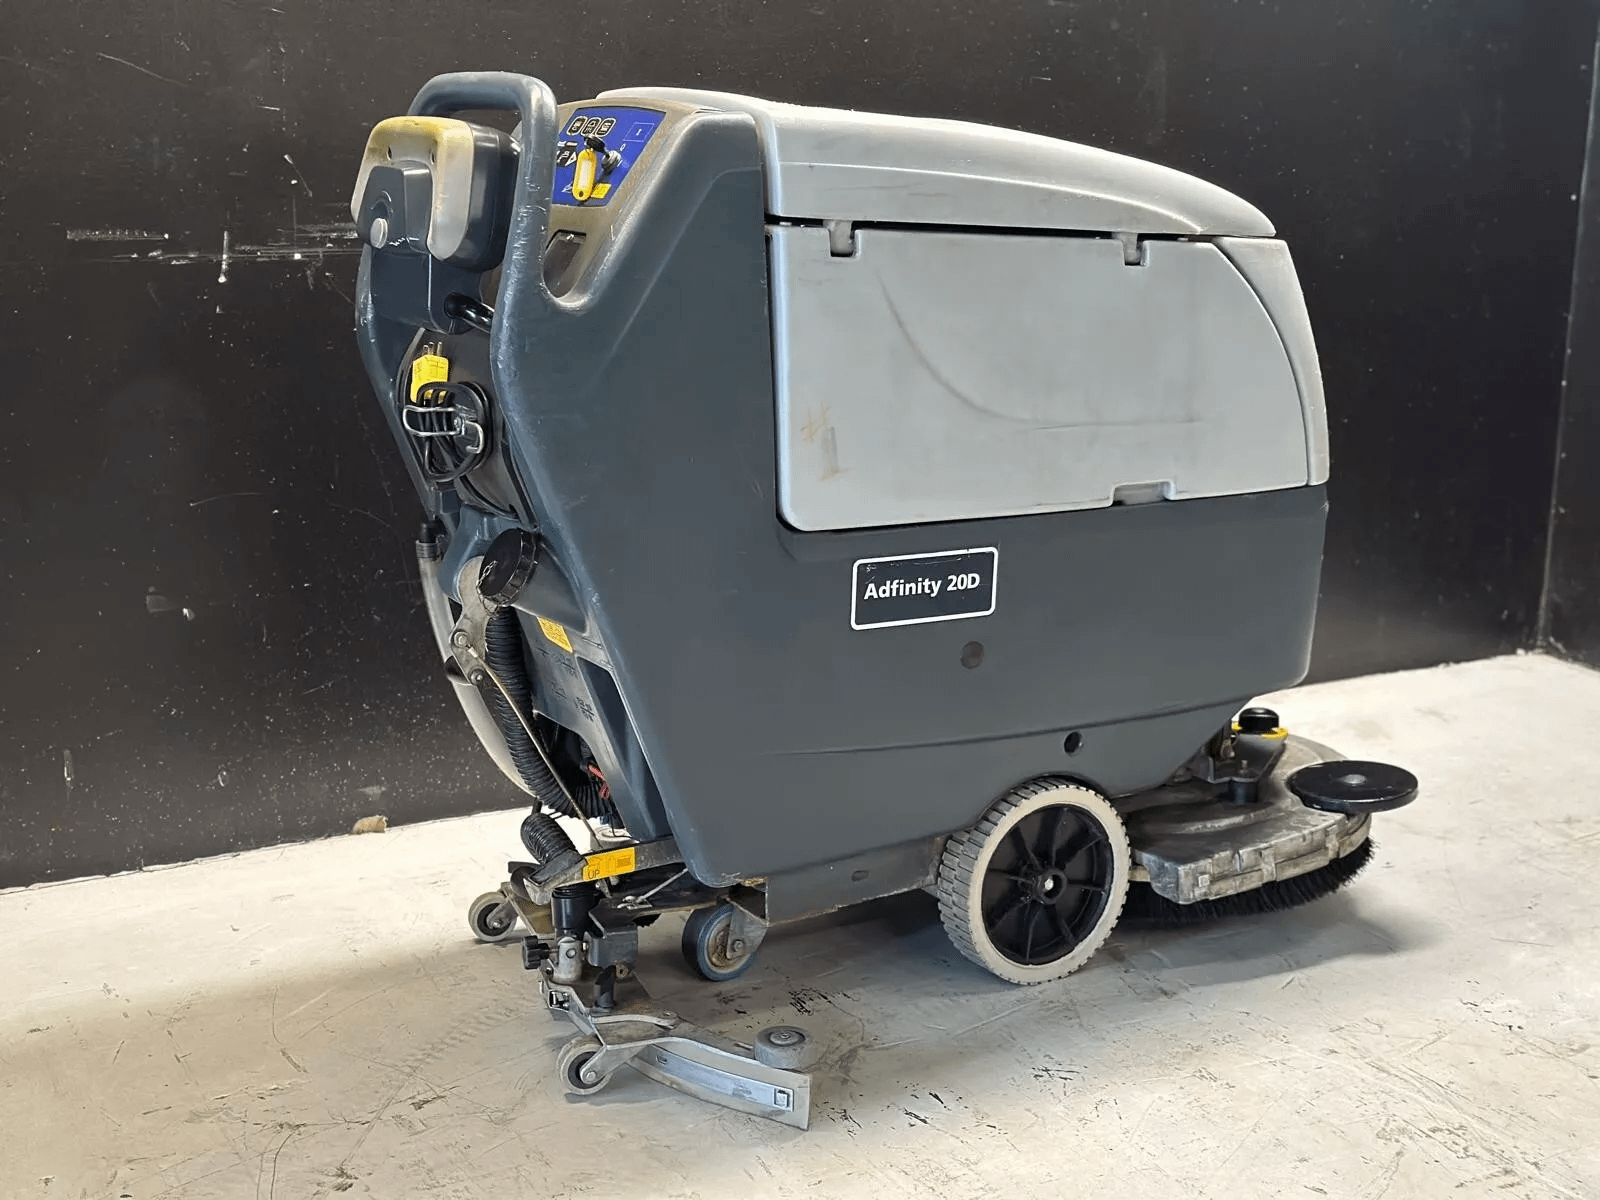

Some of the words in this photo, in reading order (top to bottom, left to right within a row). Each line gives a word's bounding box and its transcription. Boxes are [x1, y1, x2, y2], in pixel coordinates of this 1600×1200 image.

[863, 577, 942, 600] Adfinity
[947, 573, 981, 592] 20D
[587, 869, 600, 879] UP
